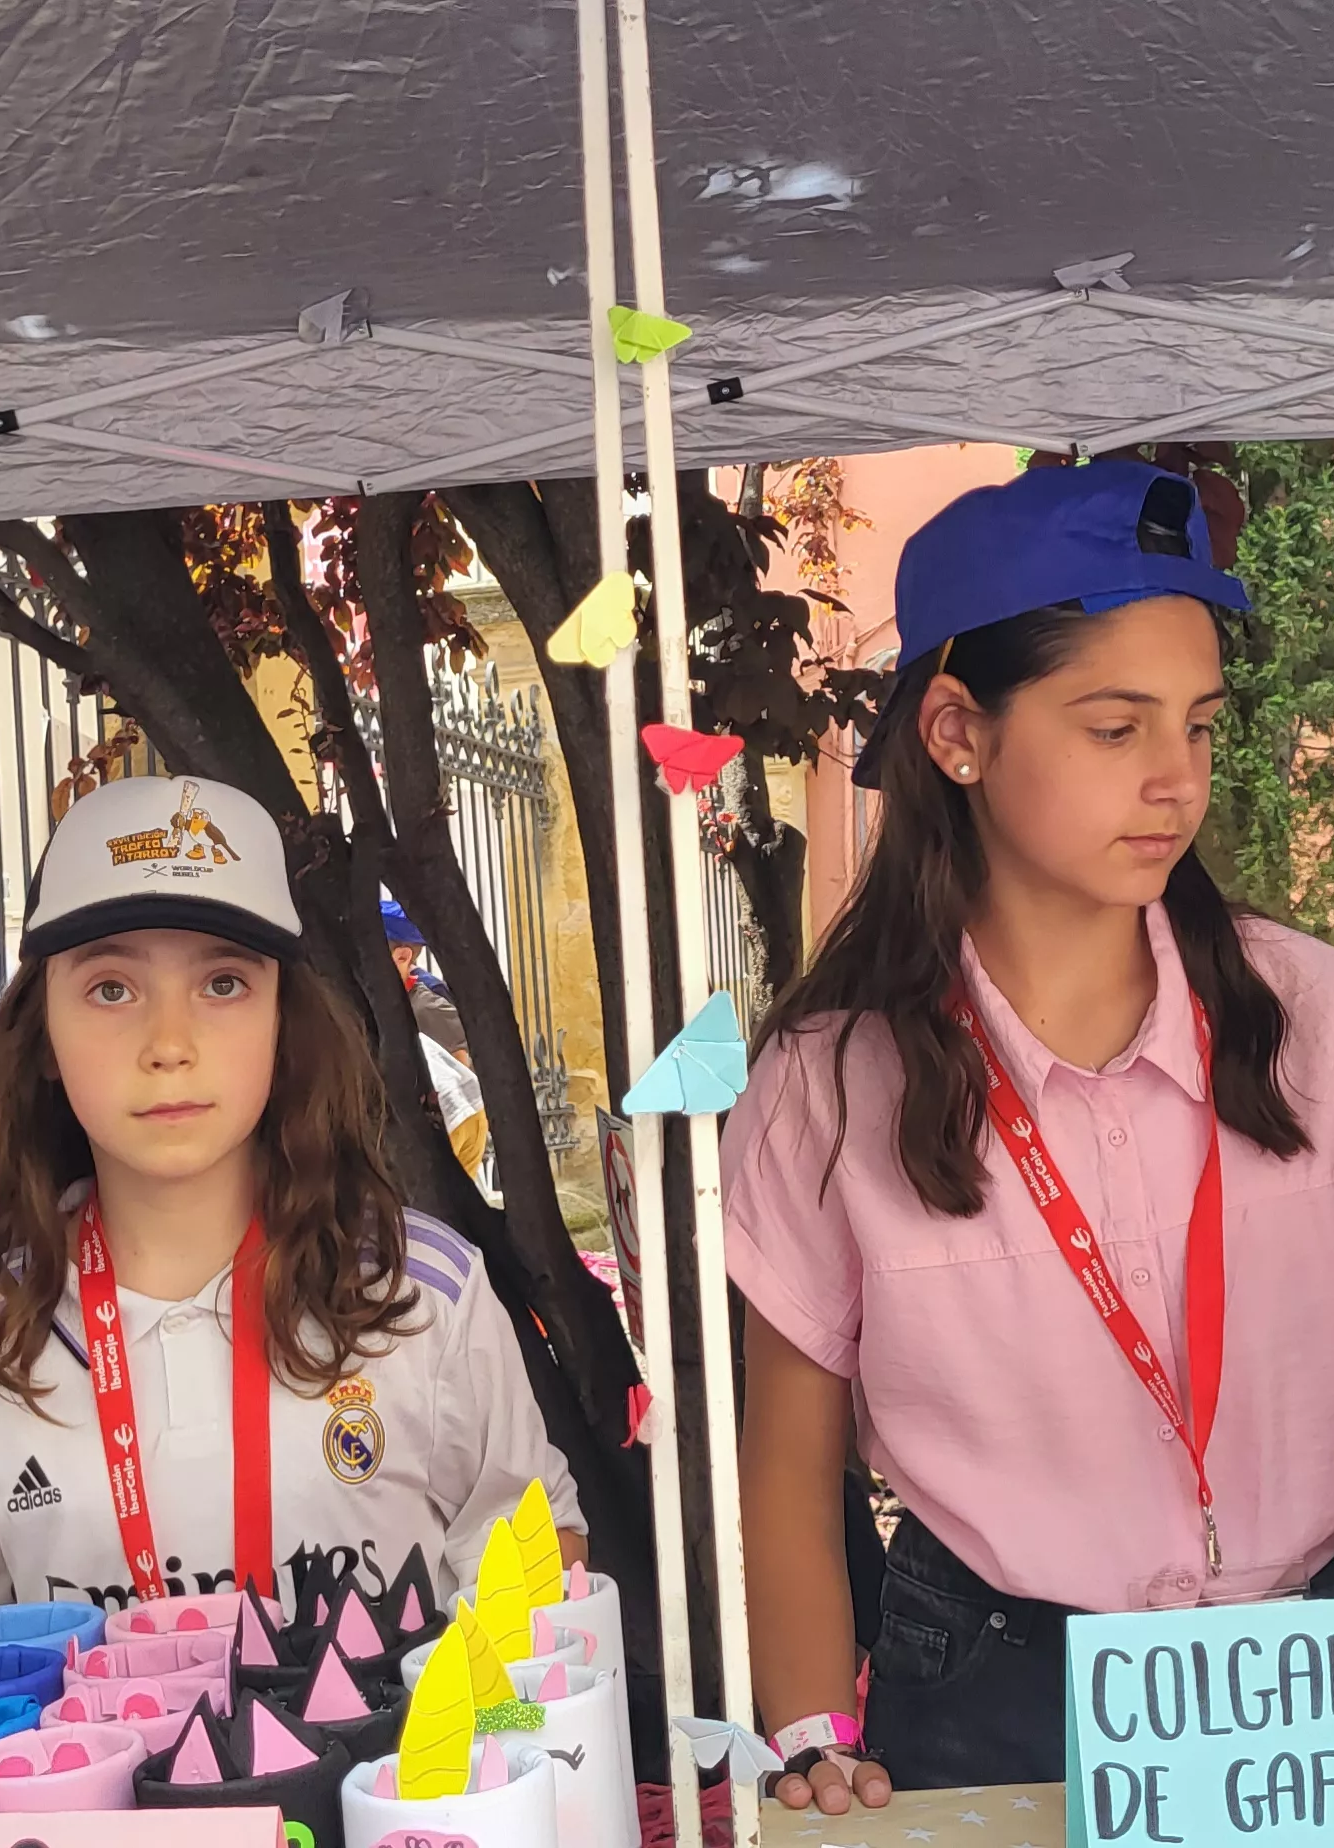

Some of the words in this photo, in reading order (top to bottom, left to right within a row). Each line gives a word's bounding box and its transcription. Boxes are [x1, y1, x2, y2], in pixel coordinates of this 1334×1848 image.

[113, 839, 161, 854] TROFEO
[114, 848, 178, 864] PITARROY
[1020, 1155, 1049, 1208] Fundación
[1082, 1267, 1111, 1319] Fundación
[92, 1339, 109, 1394] Fundación
[7, 1487, 62, 1513] adidas
[112, 1463, 129, 1519] Fundación
[1092, 1761, 1184, 1844] DE
